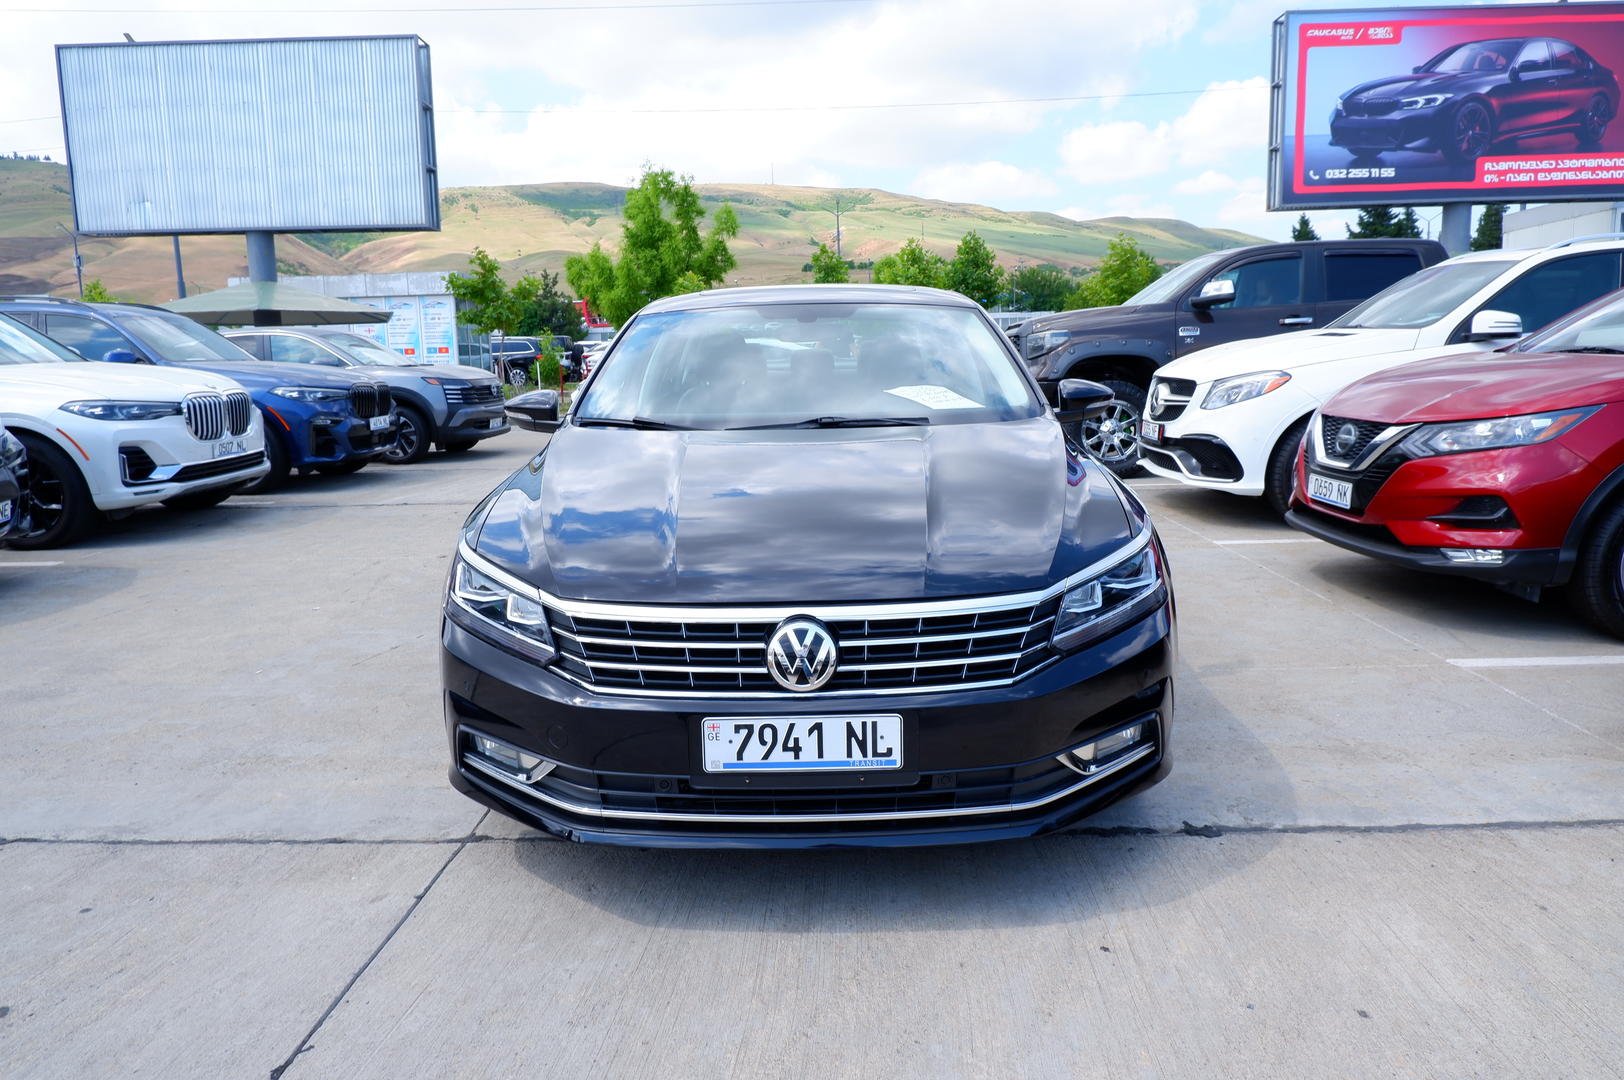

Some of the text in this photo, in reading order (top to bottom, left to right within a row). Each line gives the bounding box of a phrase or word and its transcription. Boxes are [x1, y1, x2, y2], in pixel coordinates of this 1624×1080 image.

[1306, 28, 1355, 37] CAUCASUS
[1325, 169, 1347, 179] 032
[1348, 168, 1370, 178] 255
[1380, 167, 1395, 177] 55
[1313, 477, 1350, 503] 0659 NK
[707, 732, 721, 741] GE
[733, 720, 893, 762] 7941 NL
[849, 759, 886, 767] TRANSIT
